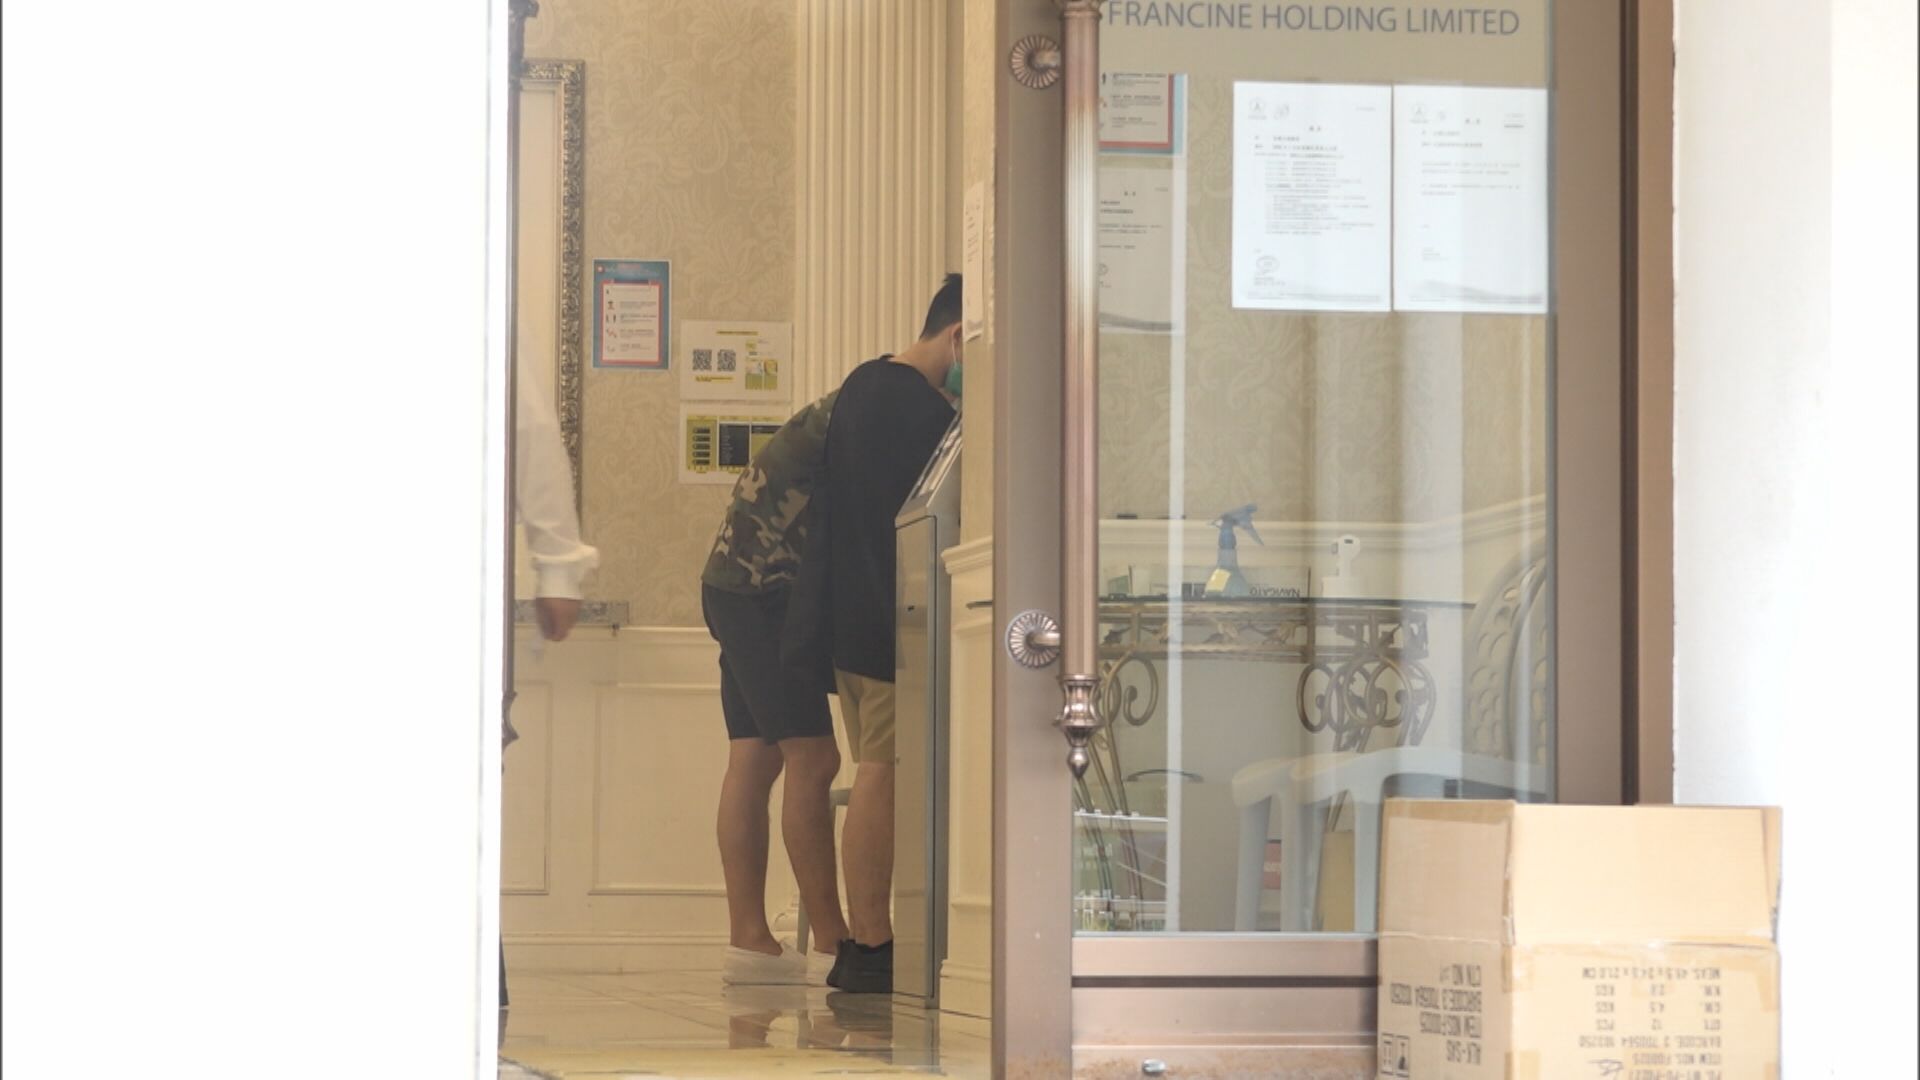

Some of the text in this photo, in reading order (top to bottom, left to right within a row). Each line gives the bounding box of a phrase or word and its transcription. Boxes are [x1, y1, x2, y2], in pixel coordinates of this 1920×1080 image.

[1107, 0, 1521, 36] FRANCINE HOLDING LIMITED
